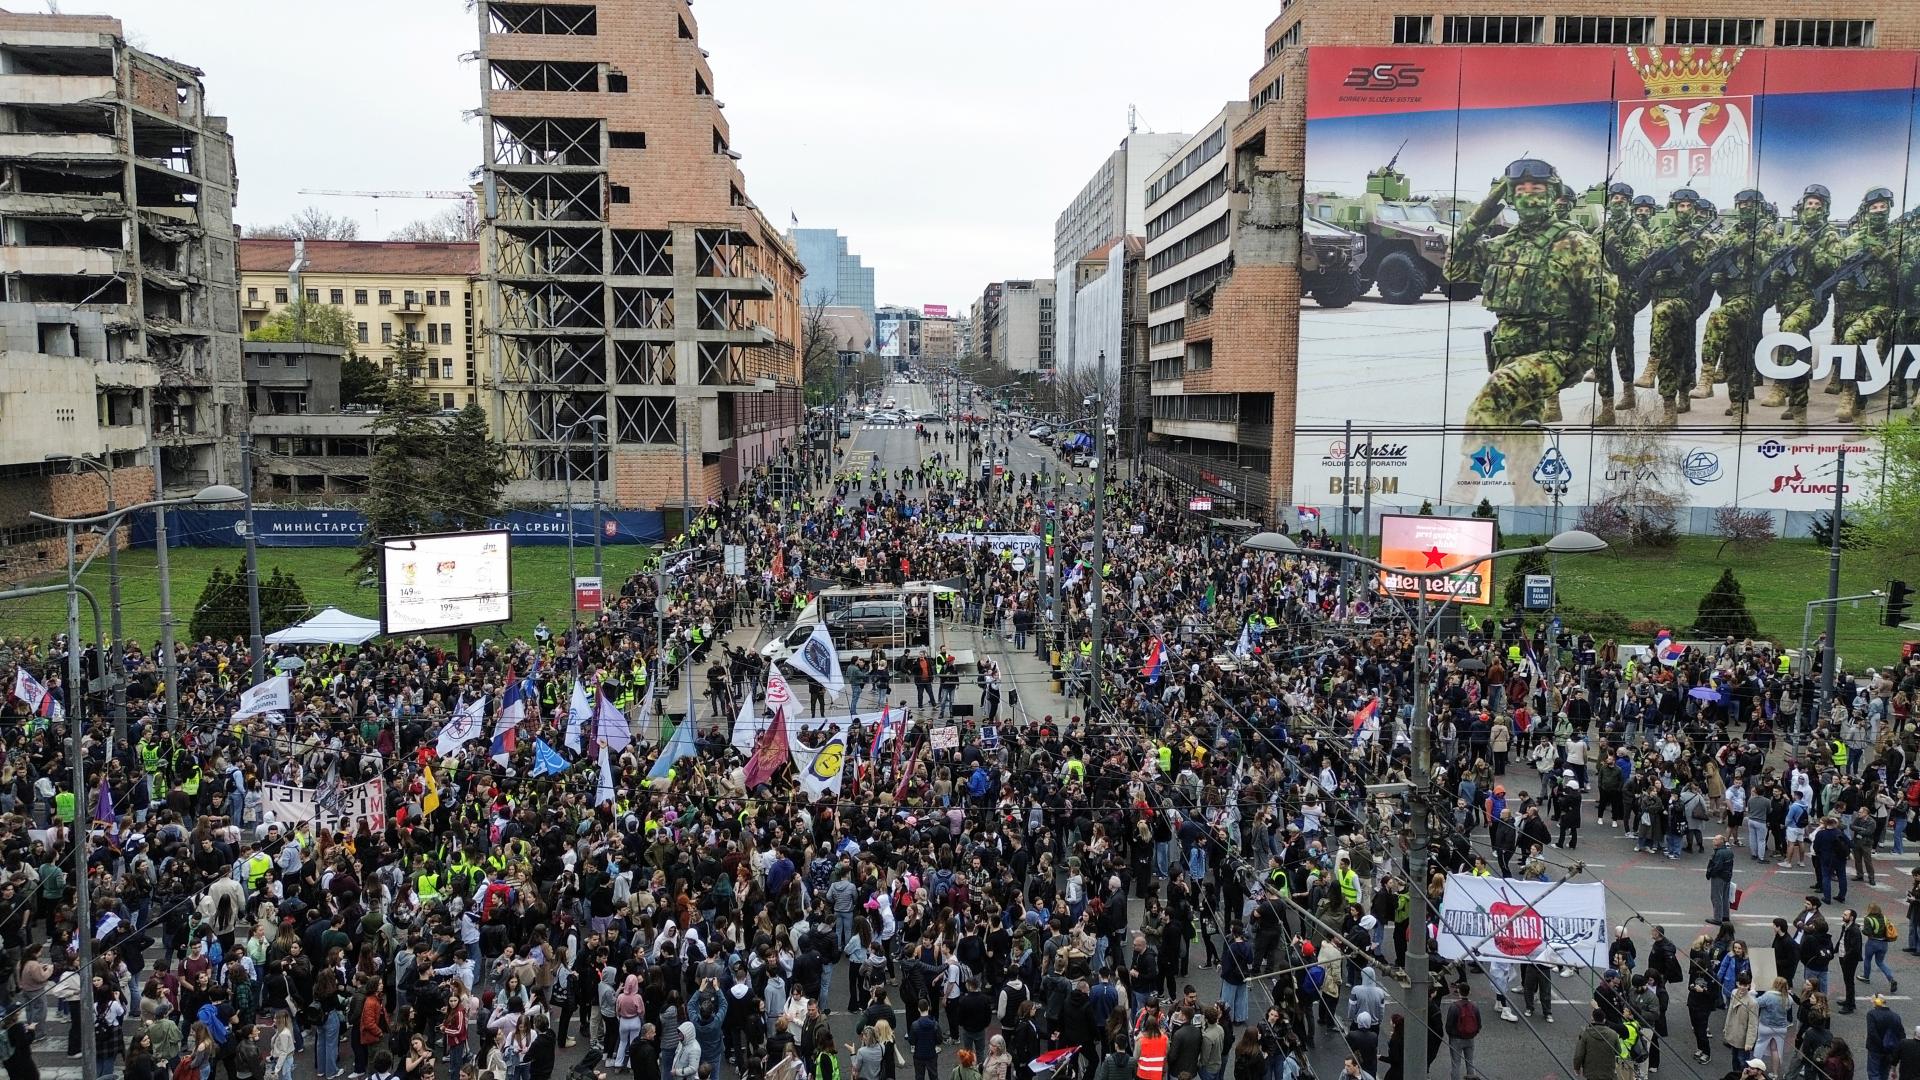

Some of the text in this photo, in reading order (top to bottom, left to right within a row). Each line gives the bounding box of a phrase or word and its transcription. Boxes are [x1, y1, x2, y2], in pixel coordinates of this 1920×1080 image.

[1343, 63, 1425, 91] BSS
[272, 522, 366, 532] МИНИСТАРСТ
[525, 522, 571, 533] СРБИЈ
[400, 588, 414, 596] 149
[440, 604, 453, 612] 199
